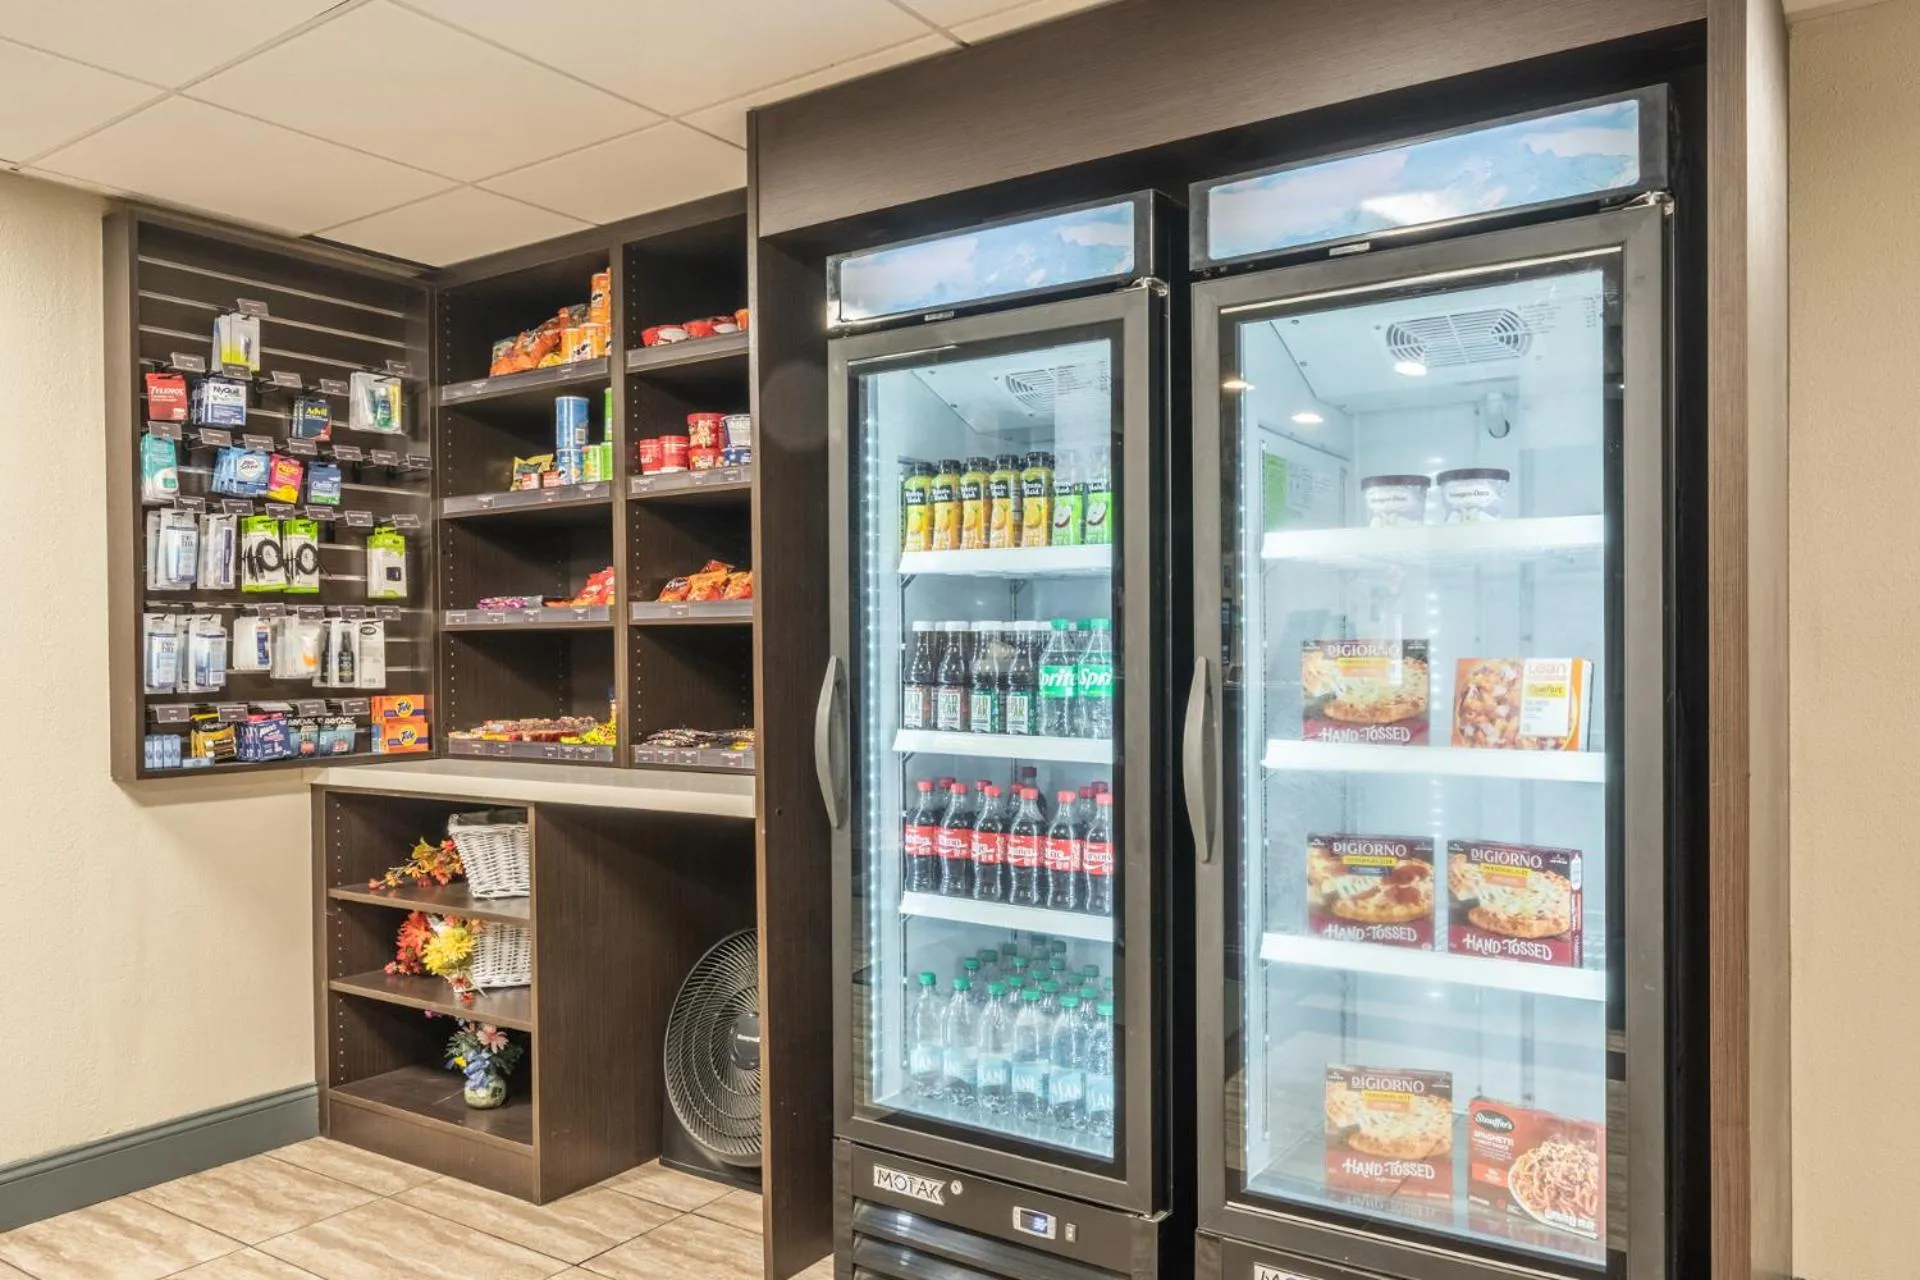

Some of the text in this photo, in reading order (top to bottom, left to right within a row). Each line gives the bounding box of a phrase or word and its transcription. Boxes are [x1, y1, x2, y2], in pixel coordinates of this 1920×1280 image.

[1327, 644, 1399, 658] DIGIORNO
[1333, 842, 1407, 857] DIGIORNO
[1471, 848, 1543, 869] DIGIORNO
[1323, 924, 1417, 942] HAND-TOSSED
[1462, 933, 1552, 961] HAND-TOSSED
[1351, 1076, 1425, 1094] DIGIORNO
[1342, 1157, 1436, 1180] HAND-TOSSED
[877, 1169, 939, 1201] MOTAK
